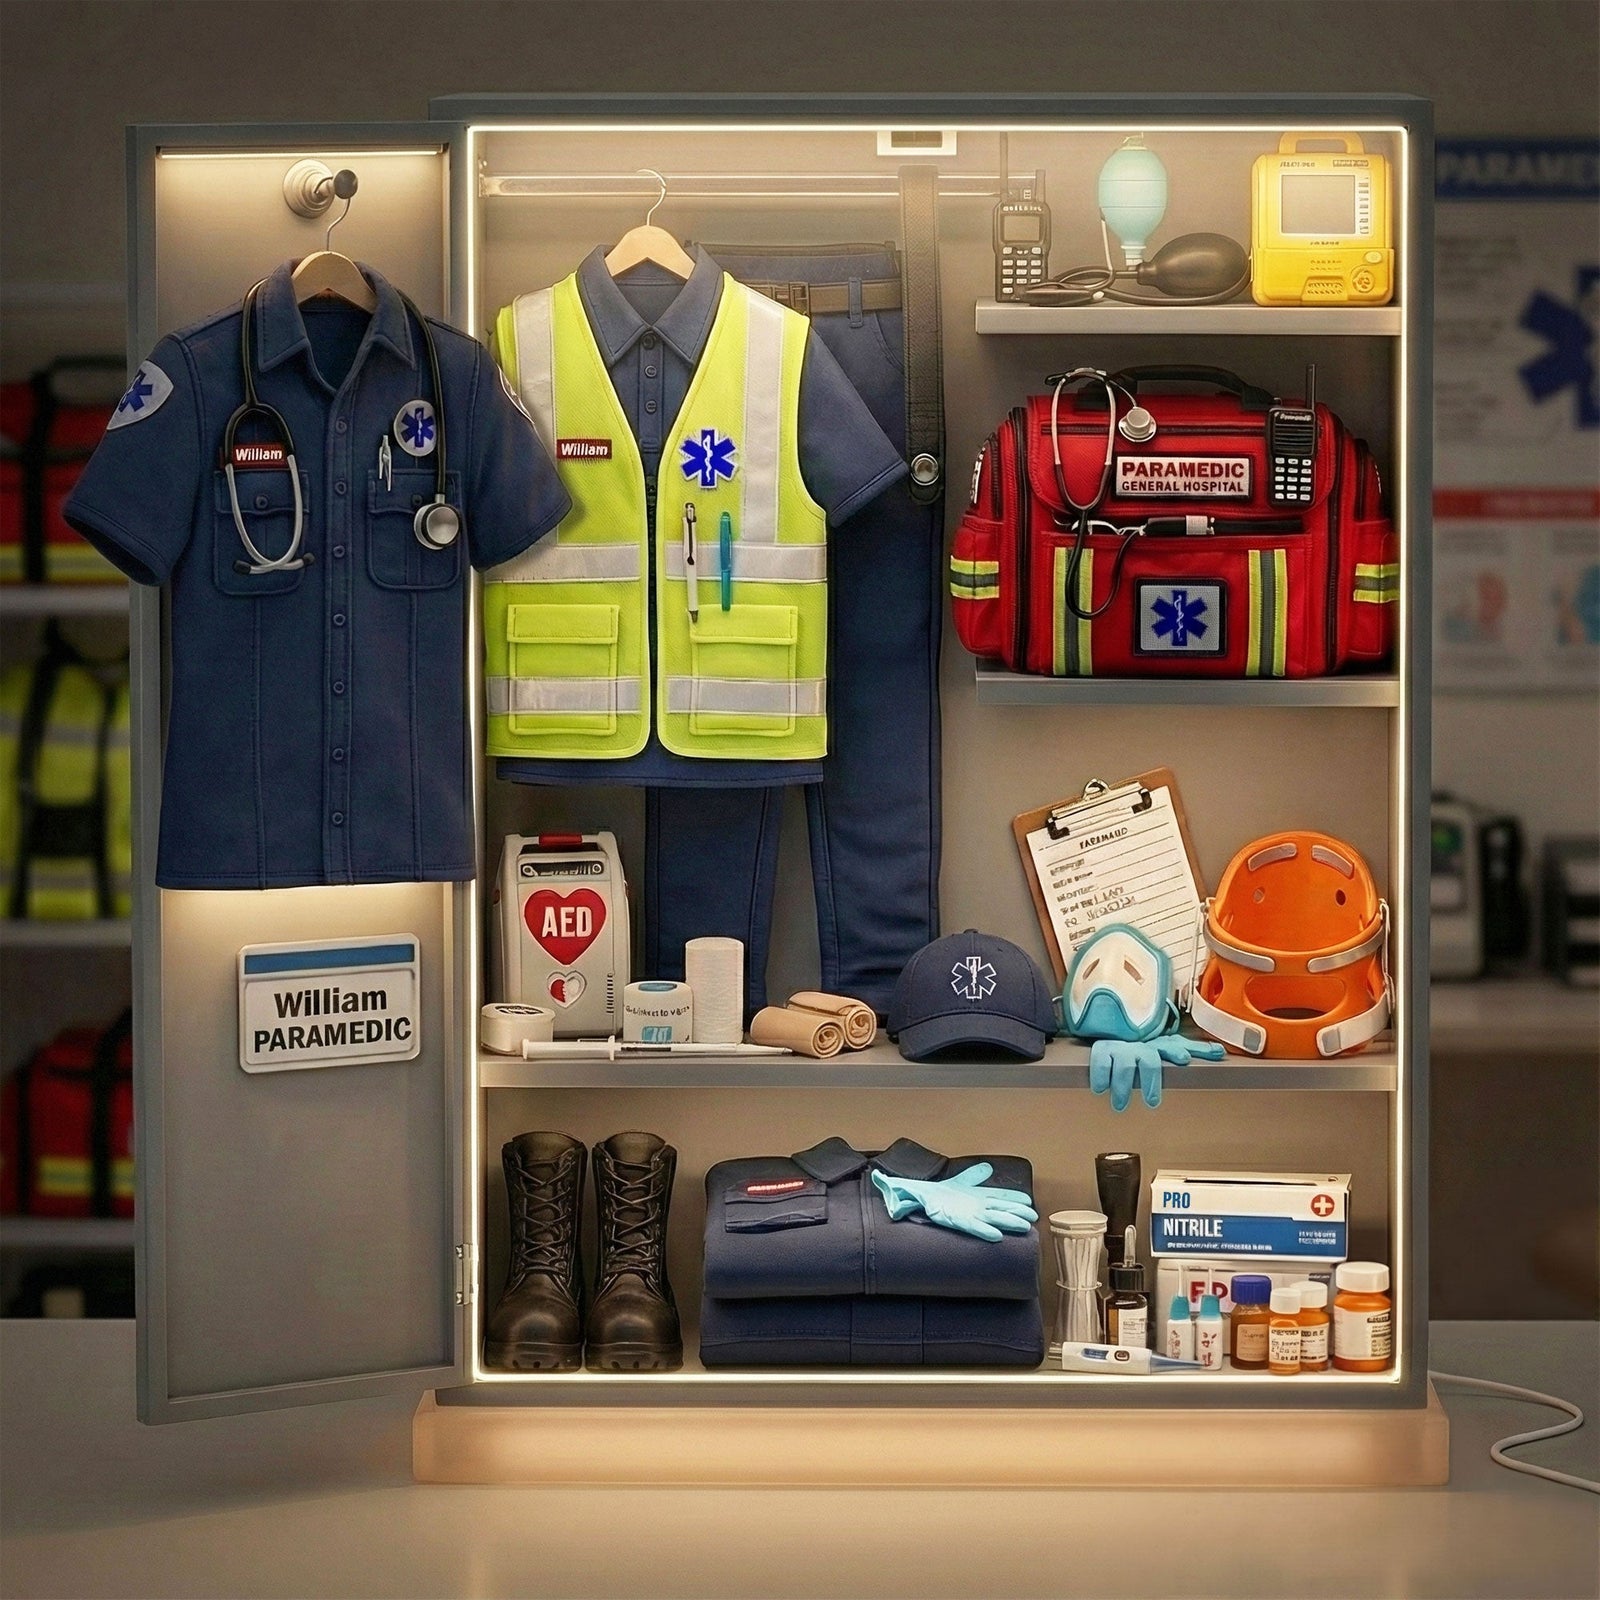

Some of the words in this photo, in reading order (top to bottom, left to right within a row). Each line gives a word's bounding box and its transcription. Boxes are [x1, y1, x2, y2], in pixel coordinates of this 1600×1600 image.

[235, 448, 283, 461] William
[561, 443, 608, 456] William
[1121, 461, 1245, 478] PARAMEDIC
[1121, 481, 1180, 491] GENERAL
[1183, 481, 1244, 492] HOSPITAL
[541, 906, 593, 938] AED
[274, 987, 387, 1019] William
[254, 1016, 412, 1053] PARAMEDIC
[1163, 1191, 1191, 1209] PRO
[1163, 1218, 1224, 1238] NITRILE
